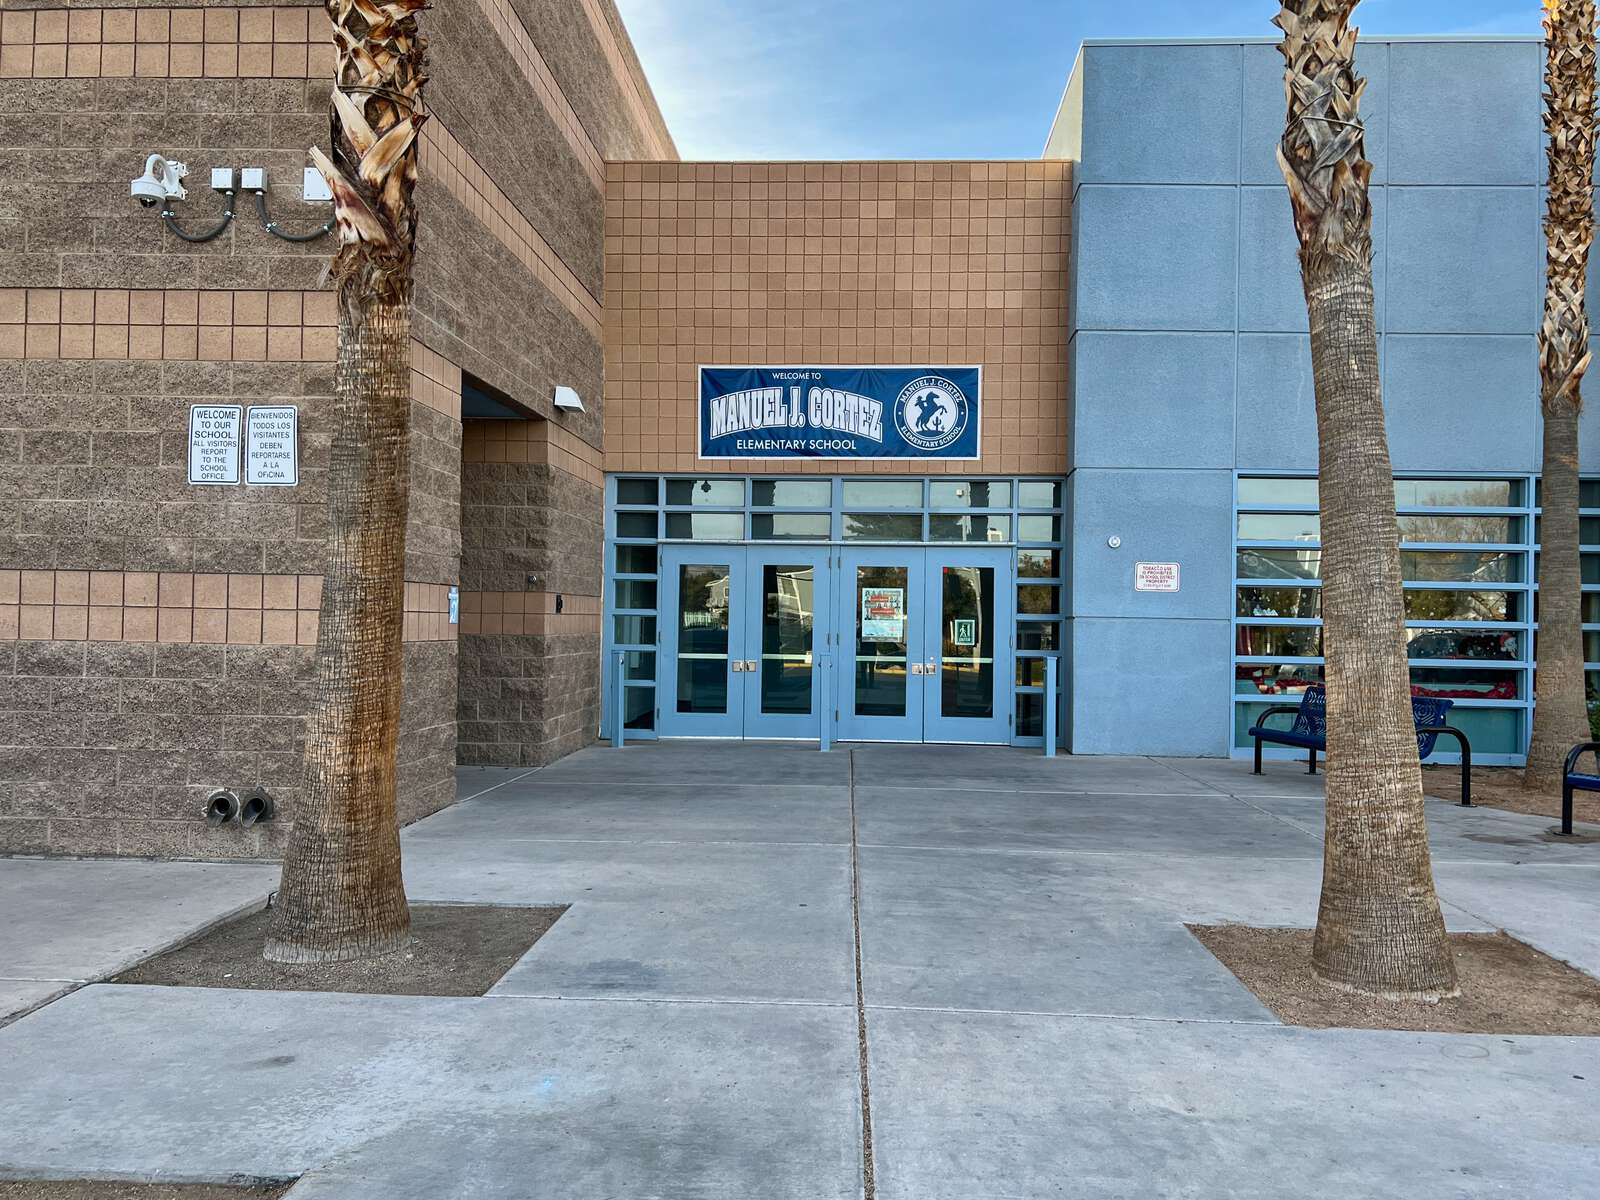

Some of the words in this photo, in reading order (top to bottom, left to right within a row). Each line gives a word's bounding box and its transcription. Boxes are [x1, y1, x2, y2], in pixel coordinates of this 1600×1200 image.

[772, 372, 809, 380] WELCOME
[810, 372, 822, 380] TO
[899, 379, 929, 402] MANUEL
[938, 380, 963, 403] CORTEZ
[197, 410, 237, 419] WELCOME
[710, 386, 788, 440] MANUEL
[789, 387, 804, 427] J.
[808, 386, 883, 443] CORTEZ
[900, 426, 939, 447] ELEMENTARY
[939, 426, 961, 445] SCHOOL
[737, 440, 807, 449] ELEMENTARY
[809, 440, 857, 449] SCHOOL
